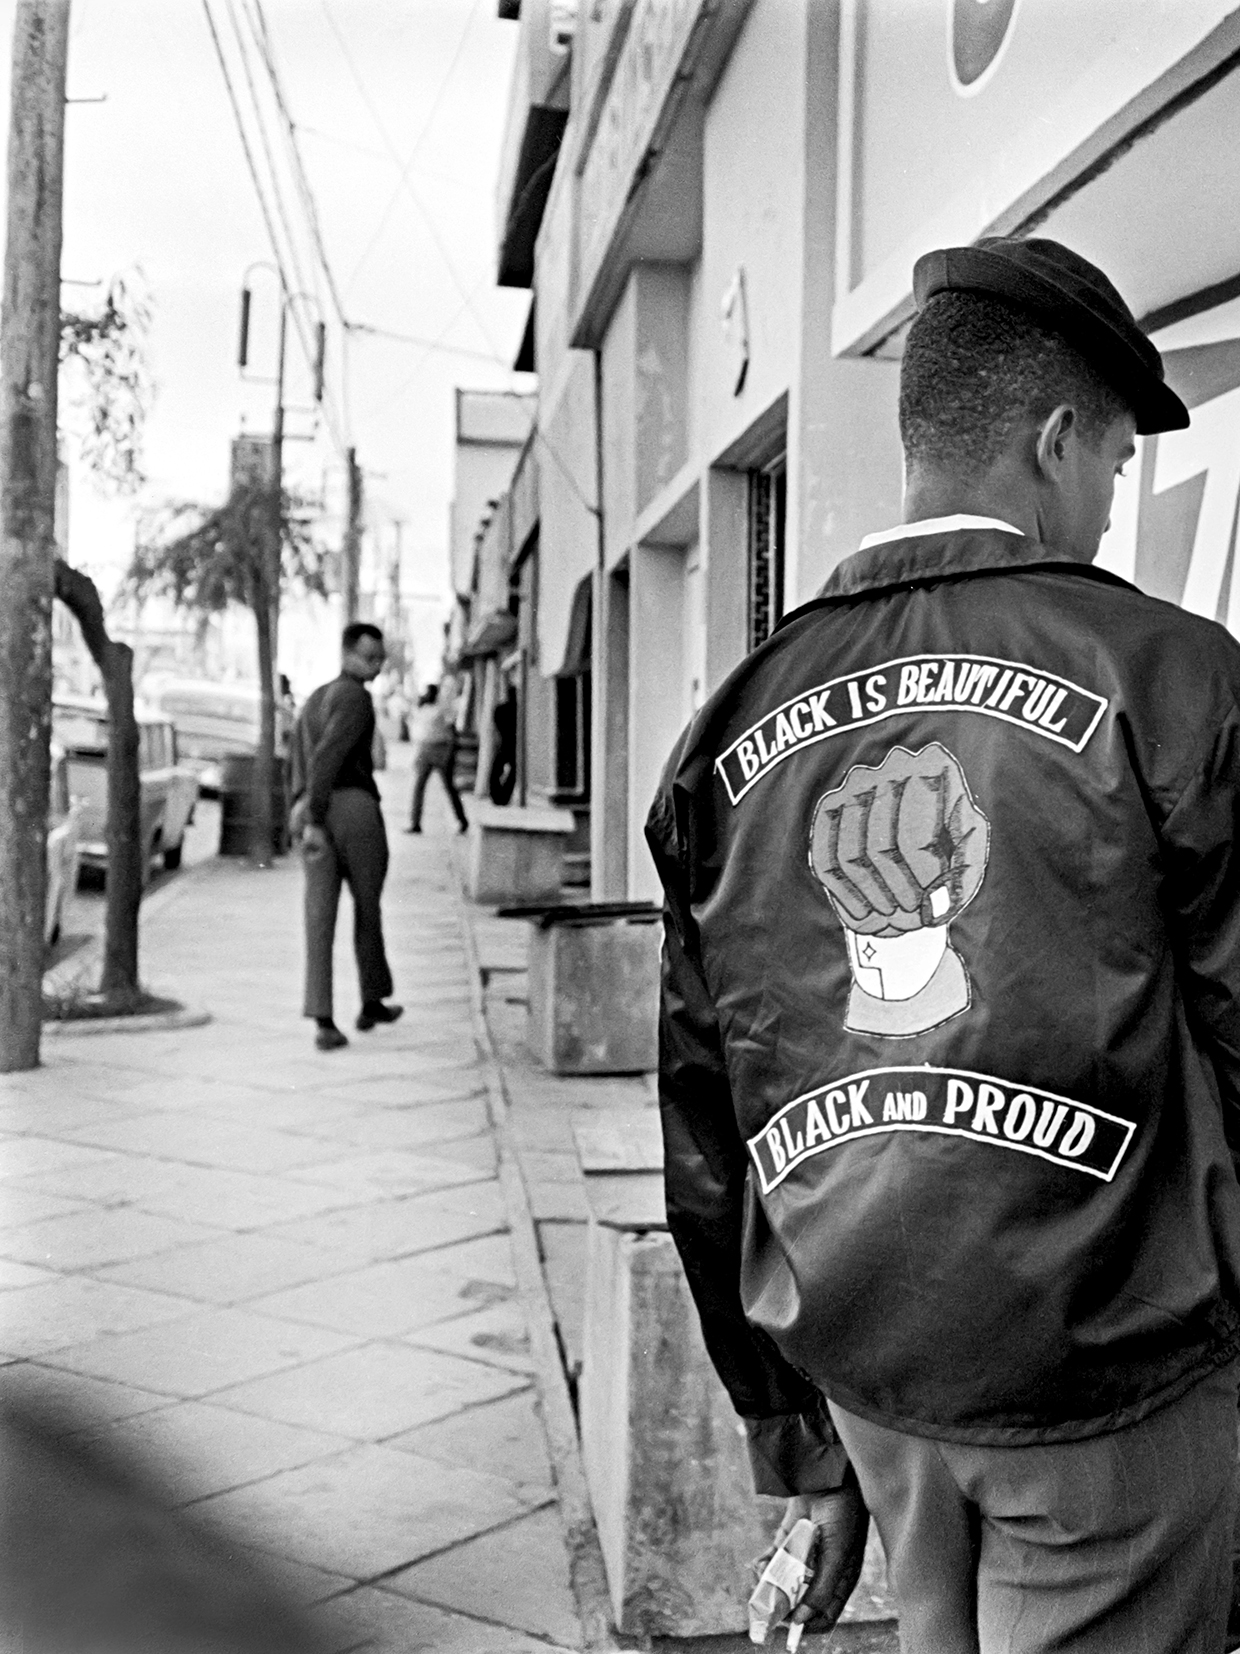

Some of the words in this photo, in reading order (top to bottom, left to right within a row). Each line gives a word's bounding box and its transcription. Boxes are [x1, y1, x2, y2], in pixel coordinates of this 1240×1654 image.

[737, 689, 834, 781] BLACK
[848, 674, 887, 719] IS
[896, 659, 1069, 734] BEAUTIFUL
[765, 1079, 875, 1175] BLACK
[882, 1090, 928, 1122] AND
[942, 1078, 1096, 1158] PROUD
